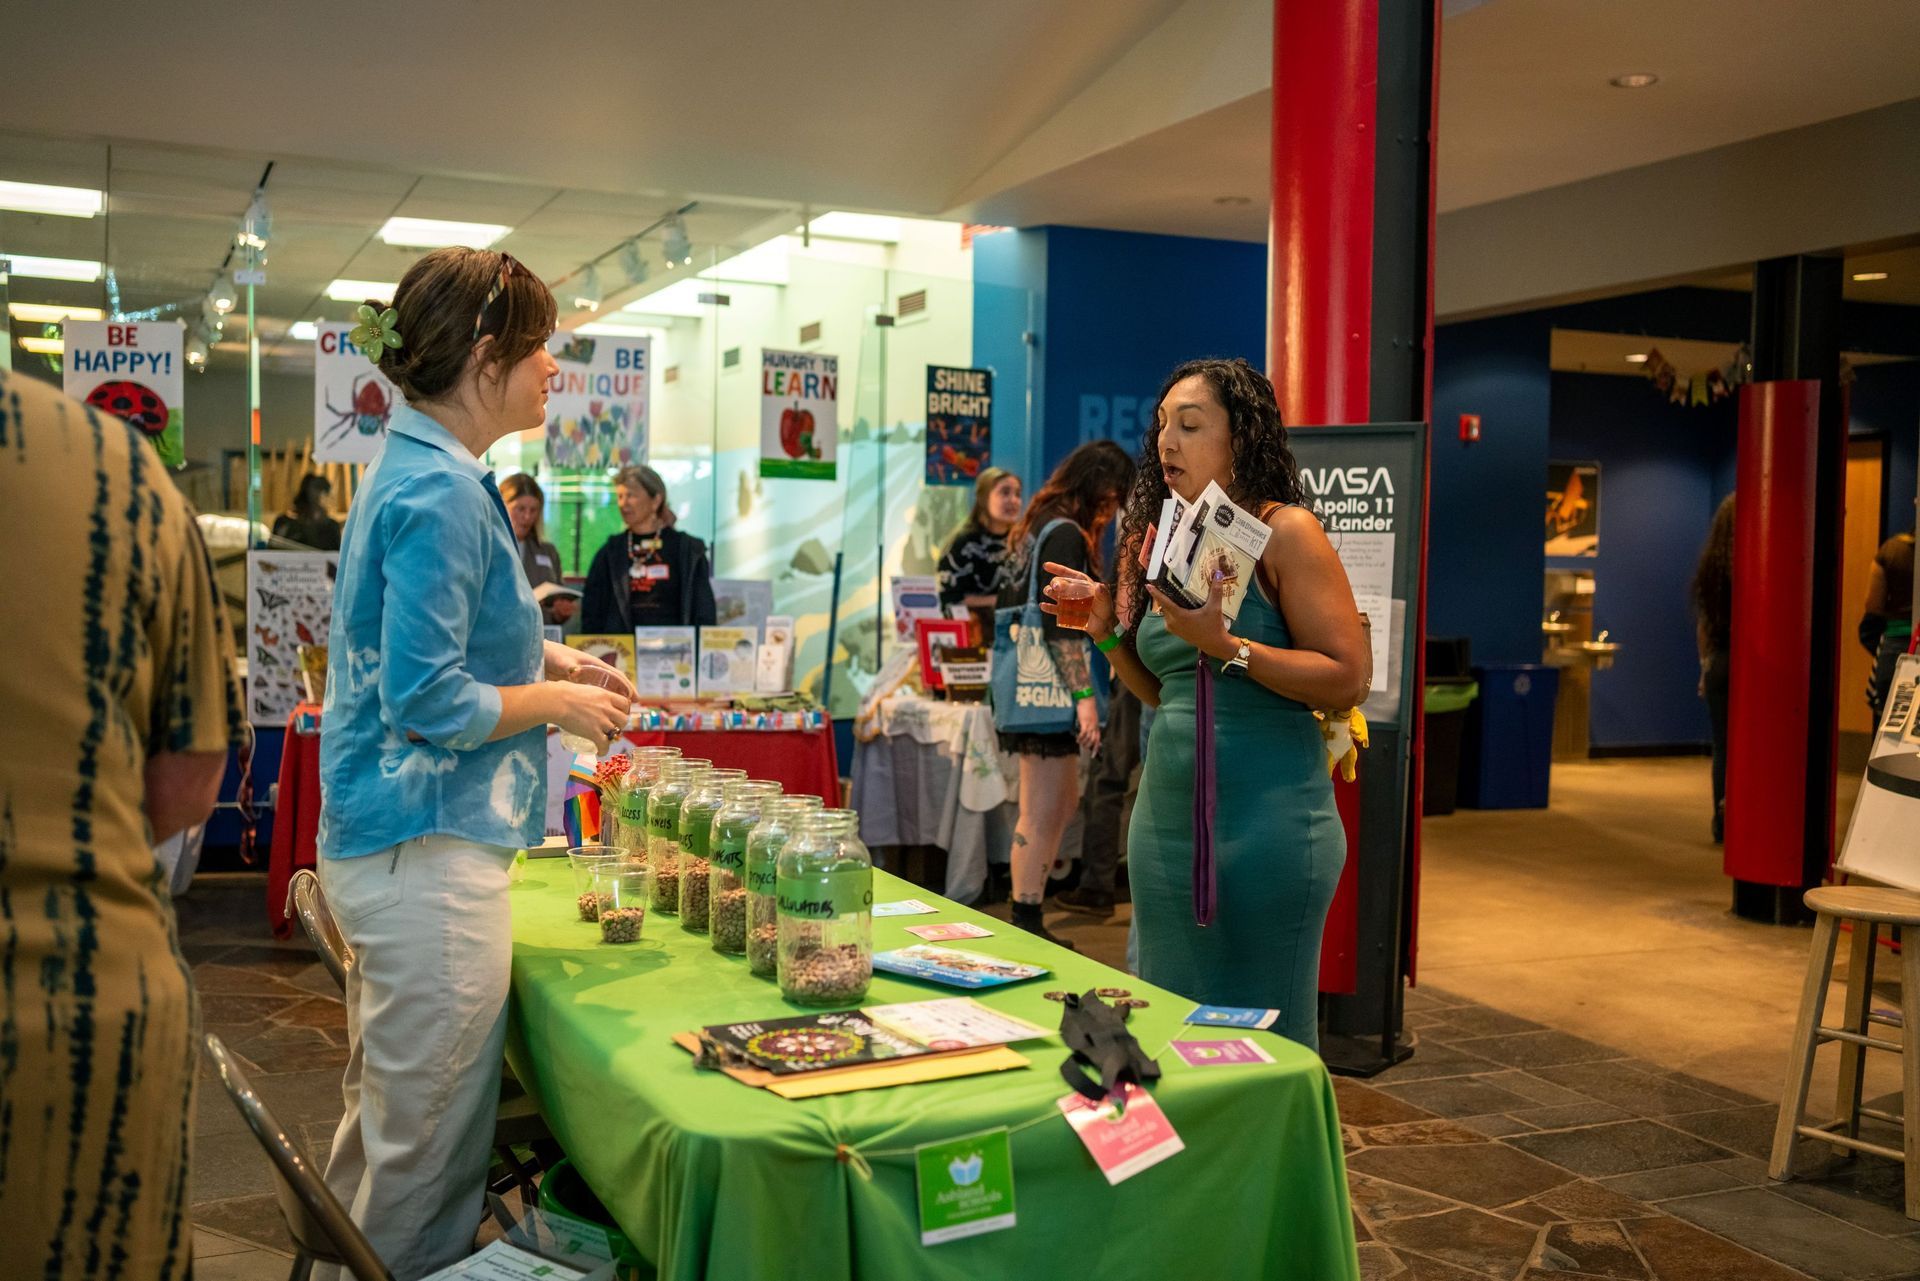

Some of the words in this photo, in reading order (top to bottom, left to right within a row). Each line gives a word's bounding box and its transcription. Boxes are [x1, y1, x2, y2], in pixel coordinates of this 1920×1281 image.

[107, 325, 138, 347] BE
[73, 350, 172, 376] HAPPY!
[615, 348, 645, 370] BE
[763, 353, 816, 370] HUNGRY
[822, 358, 838, 373] TO
[549, 370, 644, 397] UNIQUE
[763, 369, 837, 401] LEARN
[934, 368, 986, 394] SHINE
[928, 391, 991, 418] BRIGHT
[1299, 466, 1395, 495] NASA
[1313, 497, 1369, 517] Apollo
[1375, 498, 1394, 514] 11
[1331, 515, 1393, 531] Lander
